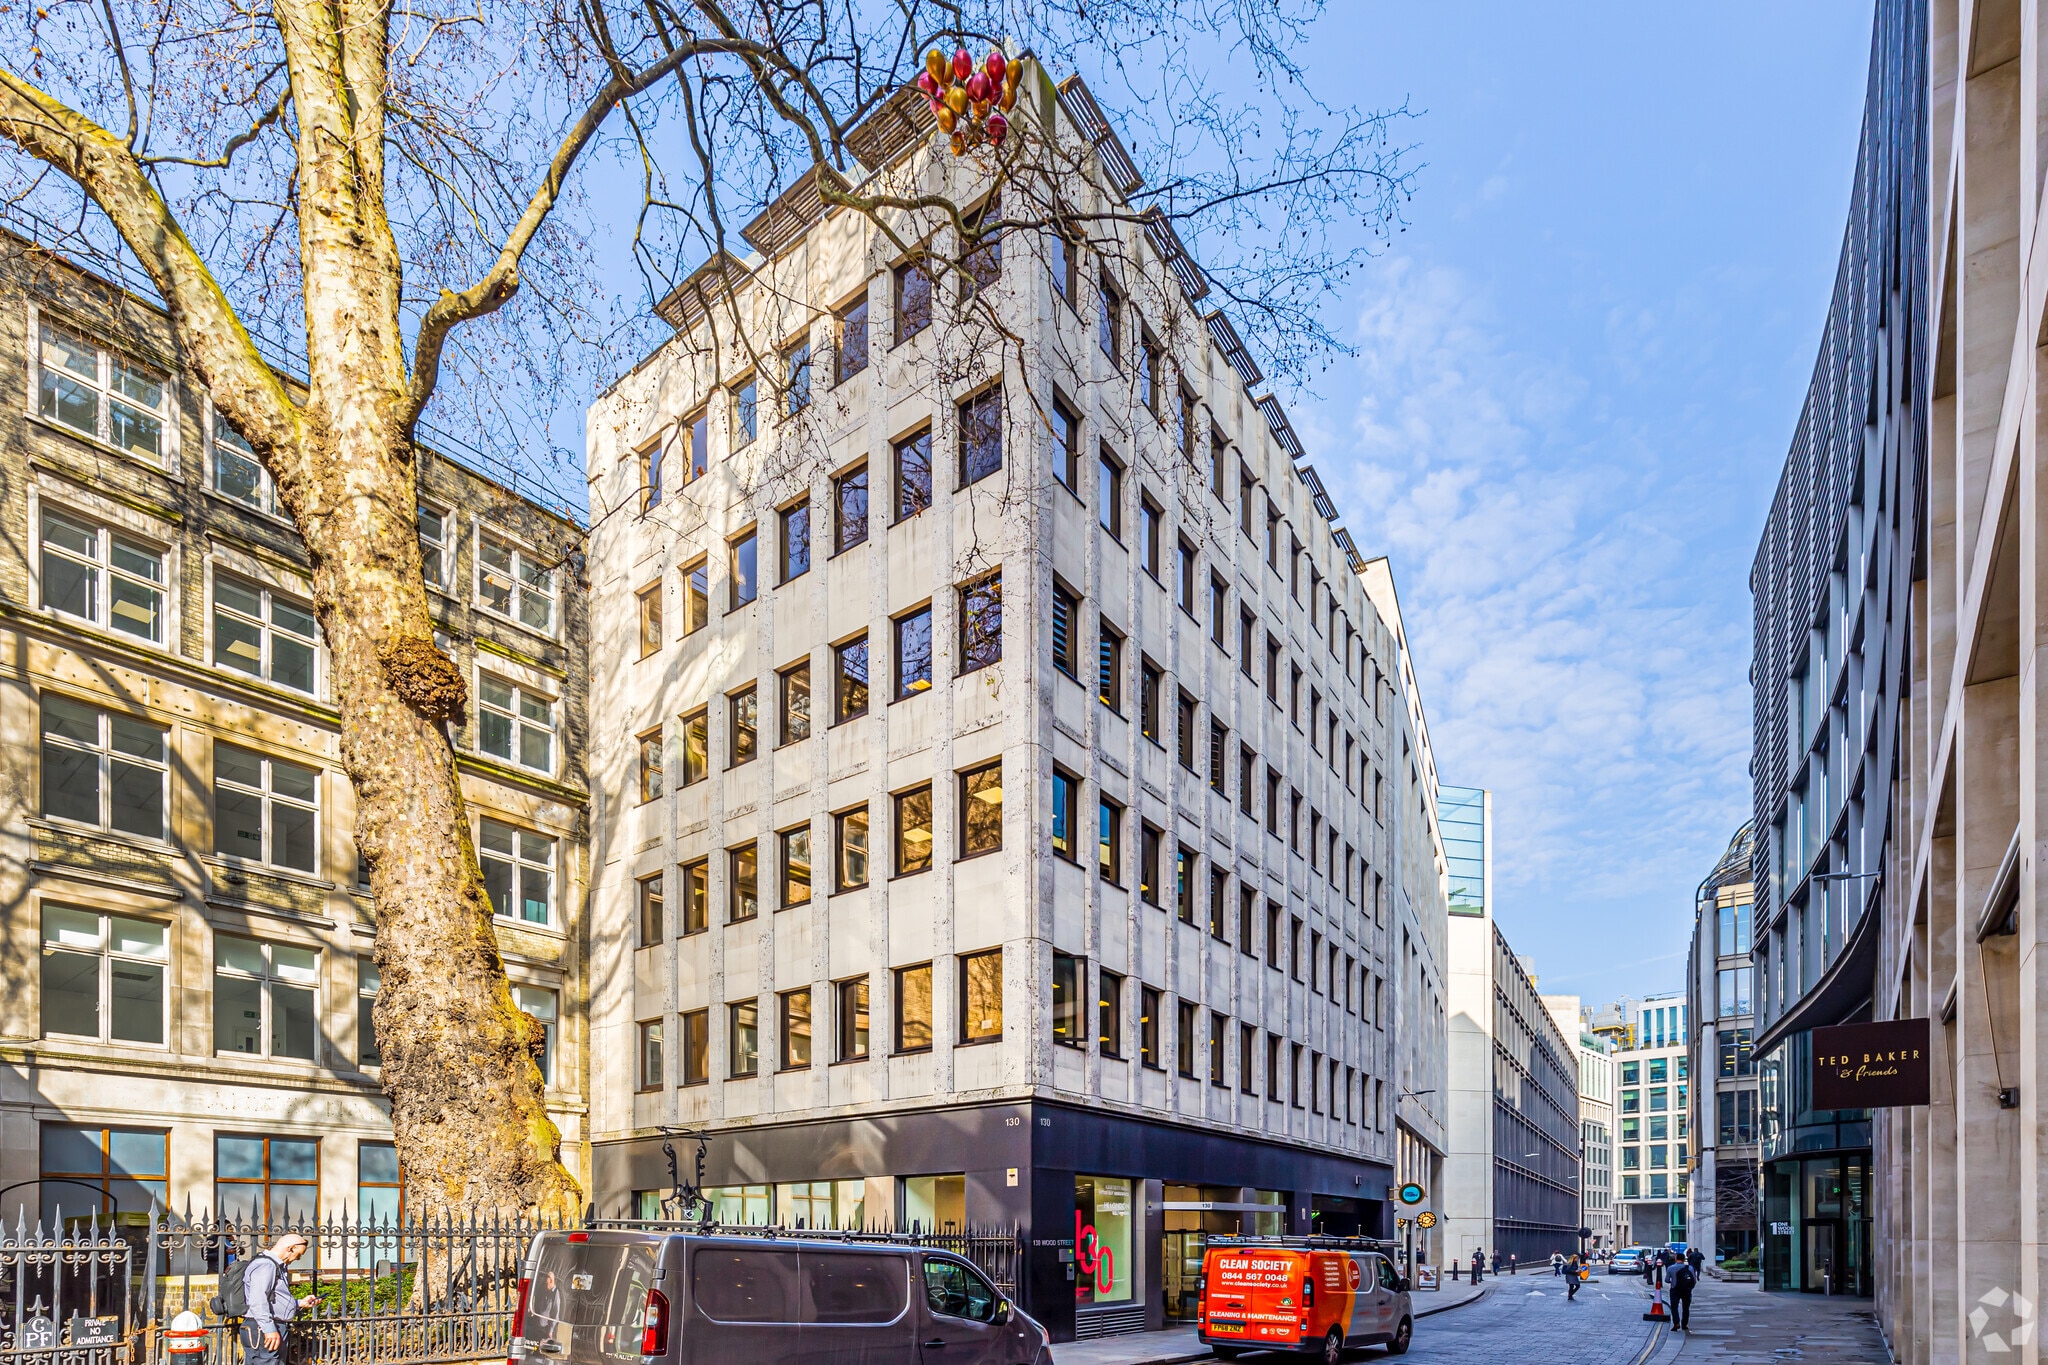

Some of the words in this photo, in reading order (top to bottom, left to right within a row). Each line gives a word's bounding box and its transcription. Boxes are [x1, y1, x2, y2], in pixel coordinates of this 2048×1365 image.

[1819, 1055, 1849, 1066] TED
[1864, 1050, 1920, 1063] BAKER
[1840, 1069, 1853, 1078] &
[1855, 1065, 1898, 1081] friends
[1005, 1117, 1020, 1127] 130
[1040, 1118, 1051, 1127] 130
[1220, 1259, 1249, 1269] CLEAN
[1251, 1260, 1293, 1271] SOCIETY
[1222, 1272, 1243, 1280] 0844
[1265, 1274, 1288, 1282] 0048
[1221, 1280, 1288, 1288] www.cleansociety.co.uk
[1247, 1313, 1297, 1322] MAINTENANCE
[84, 1319, 106, 1327] PRIVATE
[89, 1327, 101, 1335] NO
[25, 1331, 52, 1348] PF
[76, 1334, 114, 1345] ADMITTANCE
